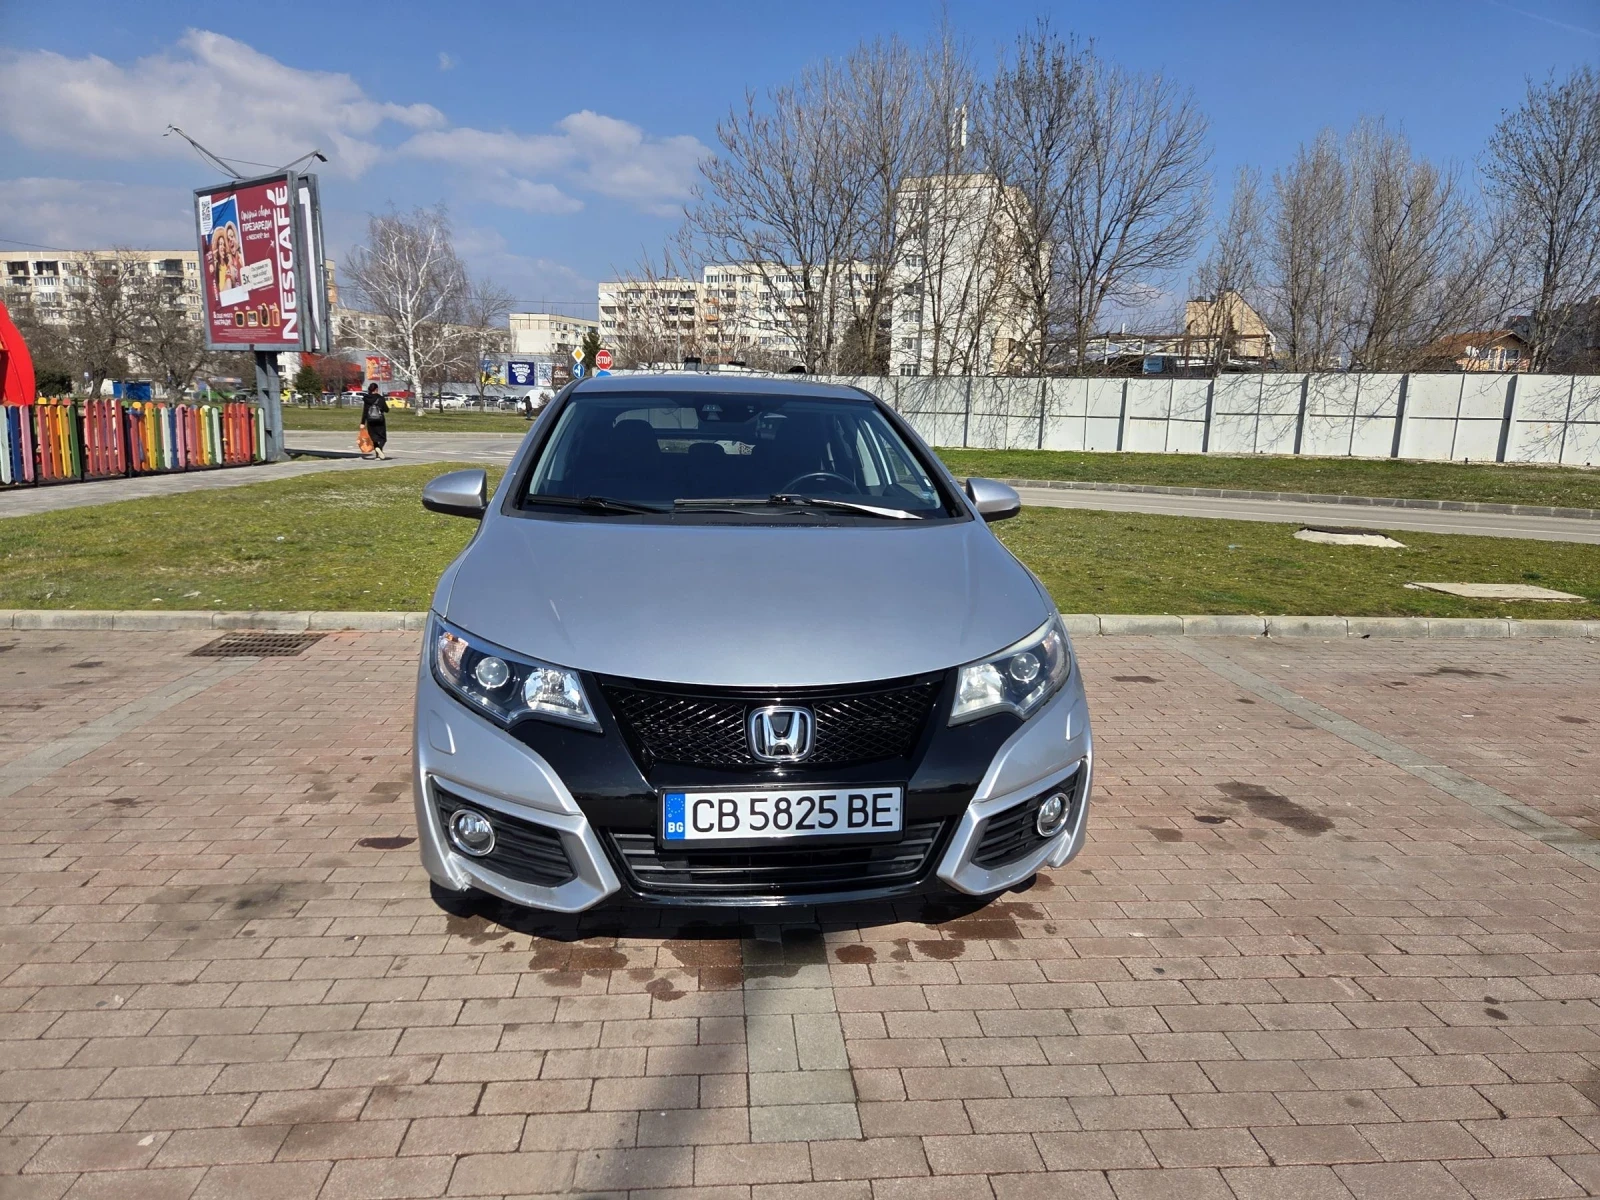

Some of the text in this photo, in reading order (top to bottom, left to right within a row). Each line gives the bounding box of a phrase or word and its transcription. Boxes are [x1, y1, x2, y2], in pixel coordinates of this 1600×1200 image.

[267, 185, 299, 340] NESCAFÉ
[597, 356, 611, 365] STOP
[692, 793, 893, 833] CB 5825 BE
[667, 821, 684, 833] BG
